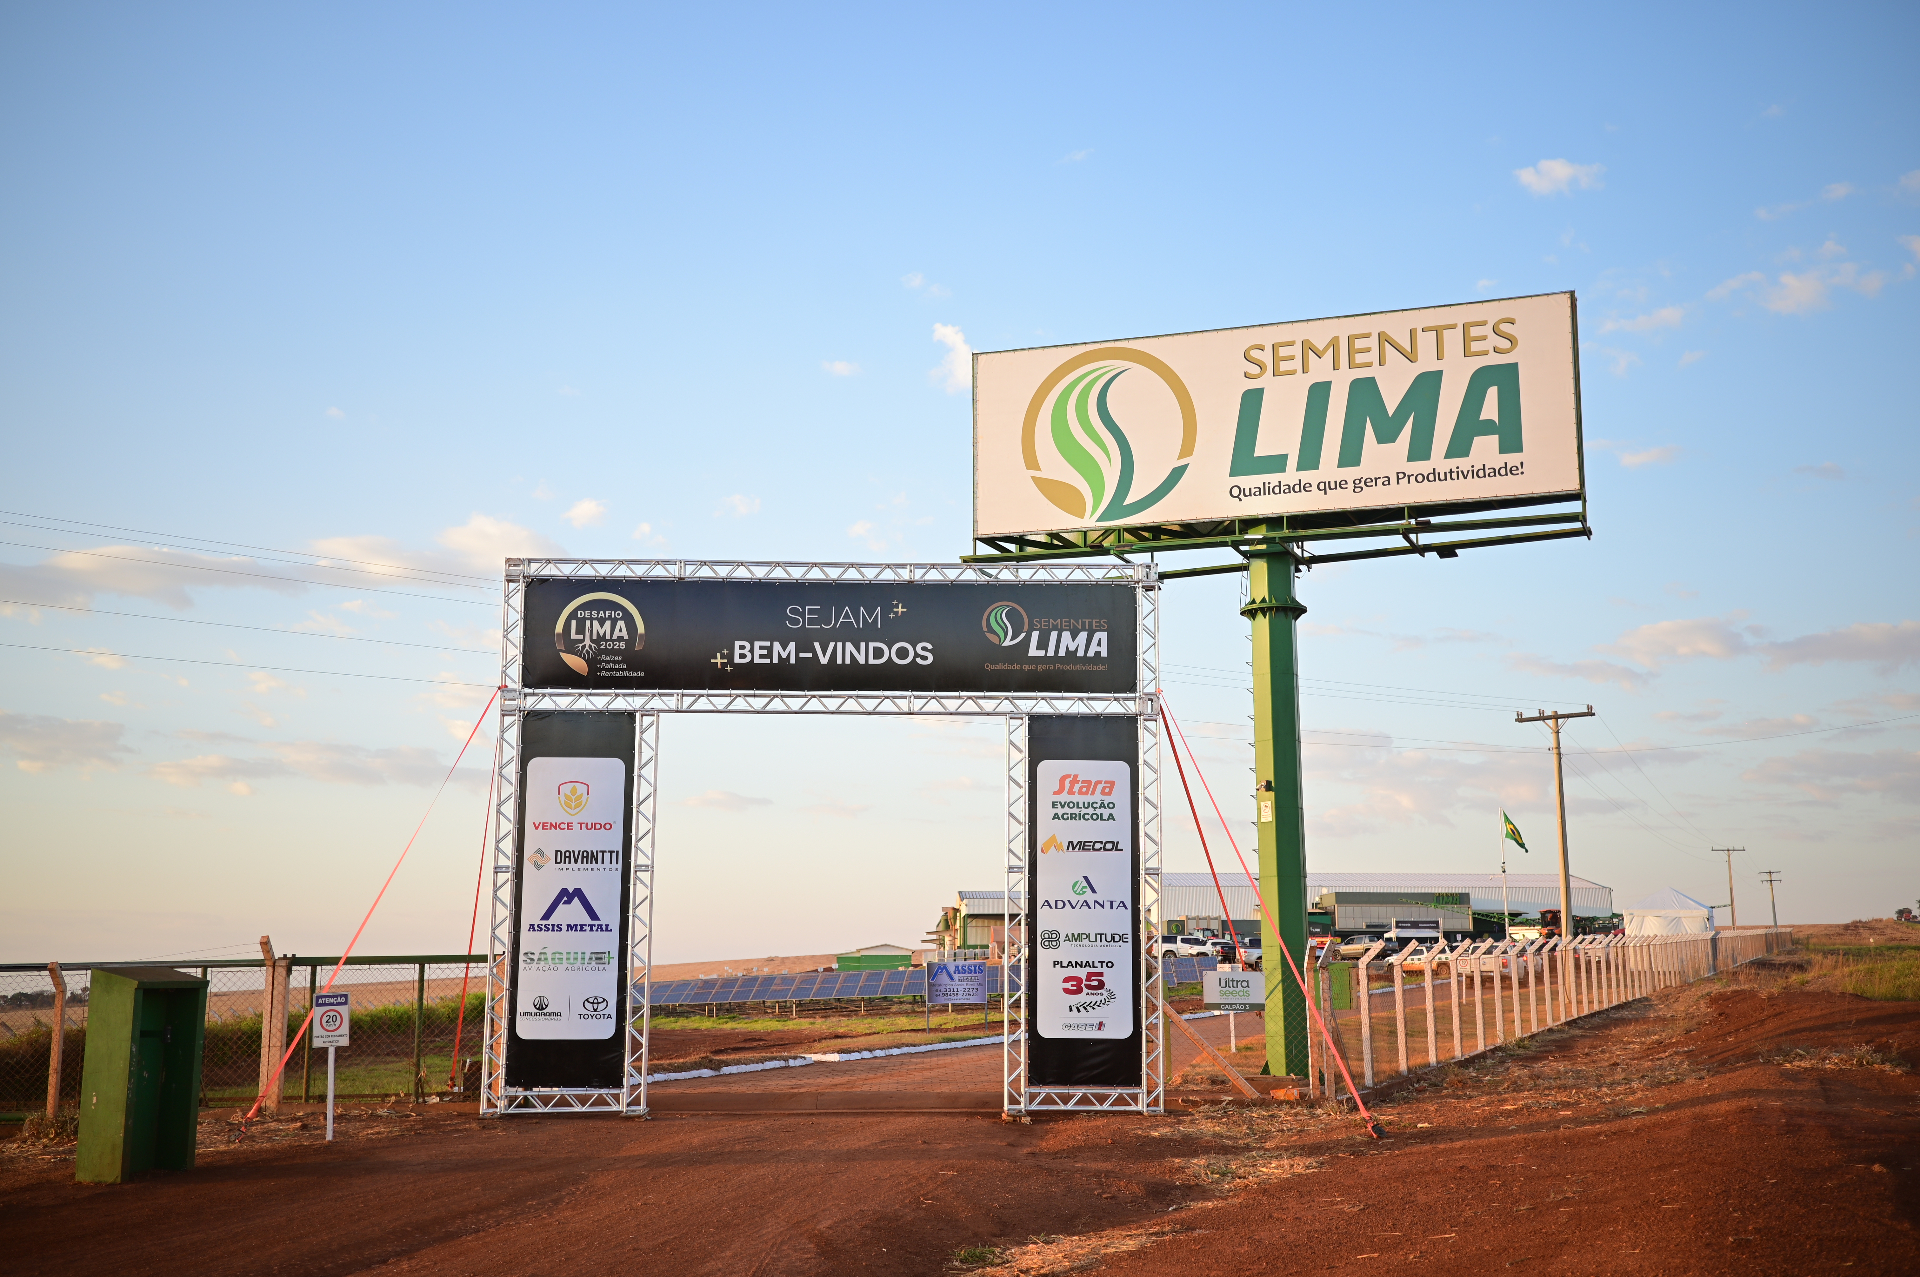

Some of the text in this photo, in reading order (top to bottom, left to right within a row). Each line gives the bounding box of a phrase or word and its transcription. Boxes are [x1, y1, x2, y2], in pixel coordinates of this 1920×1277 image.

[1243, 317, 1519, 379] SEMENTES
[1228, 362, 1524, 477] LIMA
[1229, 461, 1525, 501] Qualidade que gera Produtividade!
[577, 610, 623, 618] DESAFIO
[786, 605, 881, 629] SEJAM
[570, 619, 629, 640] LIMA
[1033, 618, 1108, 630] SEMENTES
[599, 641, 626, 649] 2025
[1028, 630, 1108, 657] LIMA
[733, 640, 934, 665] BEM-VINDOS
[984, 662, 1108, 672] Qualidade que gera Produtividade!
[1052, 773, 1116, 797] Stara
[1051, 800, 1116, 811] EVOLUÇÃO
[1051, 811, 1116, 821] AGRÍCOLA
[532, 821, 613, 831] VENCE TUDO
[1066, 840, 1124, 852] MECOL
[554, 849, 619, 865] DAVANTTI
[1040, 899, 1128, 910] ADVANTA
[528, 923, 613, 932] ASSIS METAL
[1063, 932, 1129, 943] AMPLITUDE
[954, 964, 984, 975] ASSIS
[1052, 960, 1115, 969] PLANALTO
[1062, 971, 1106, 995] 35
[1219, 988, 1250, 997] seeds
[317, 996, 346, 1004] ATENÇÃO
[325, 1014, 338, 1024] 20
